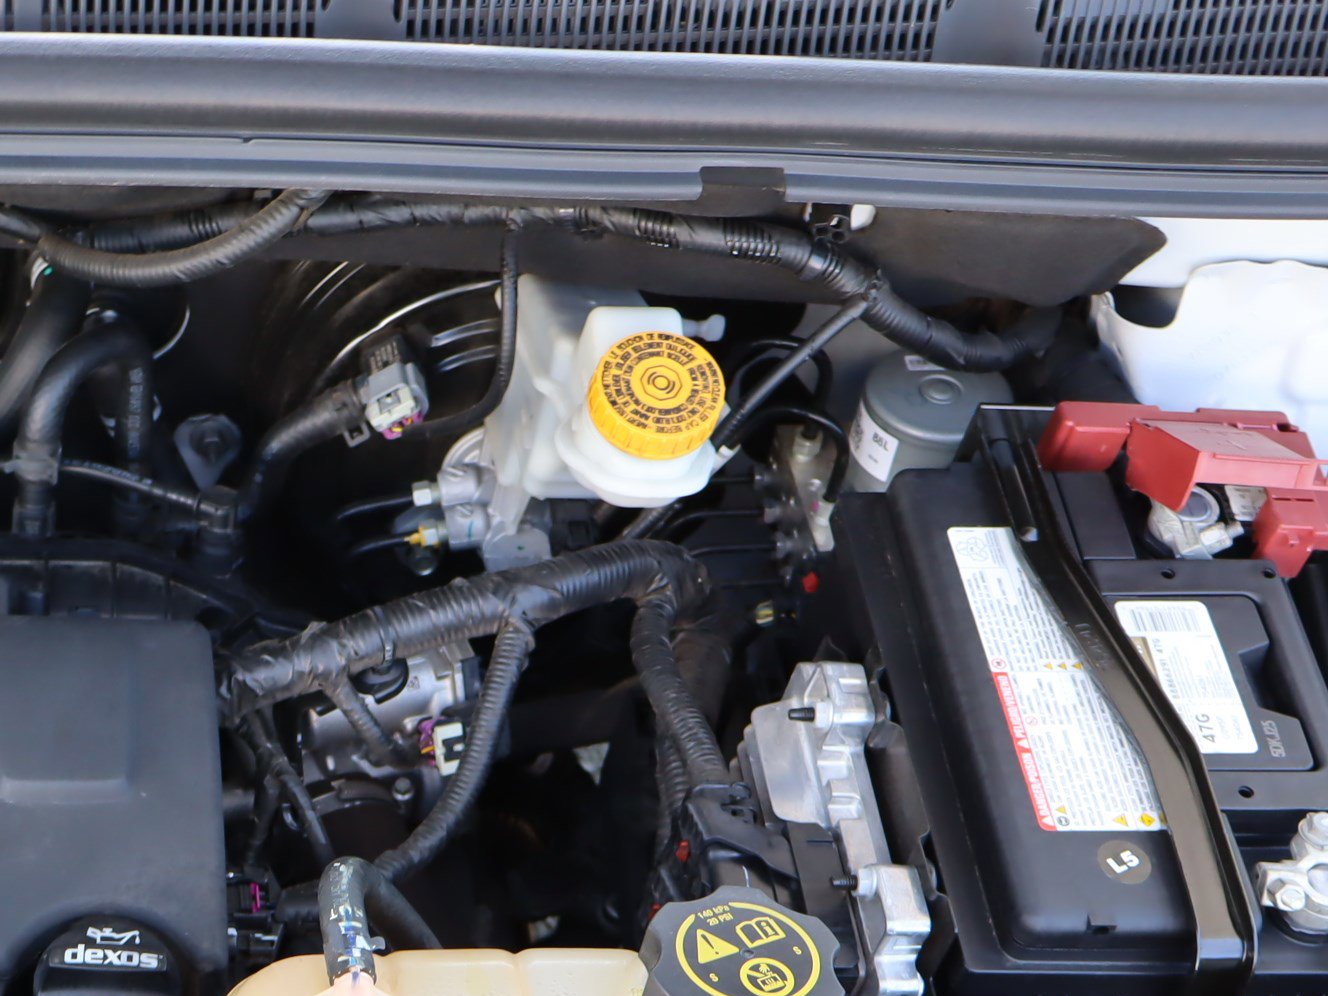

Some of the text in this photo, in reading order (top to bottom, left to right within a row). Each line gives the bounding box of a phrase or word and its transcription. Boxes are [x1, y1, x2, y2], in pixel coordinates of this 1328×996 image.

[1196, 713, 1216, 744] 47G
[1106, 850, 1140, 874] L5
[697, 904, 730, 919] 140 kPa
[706, 914, 734, 926] 20 PSI
